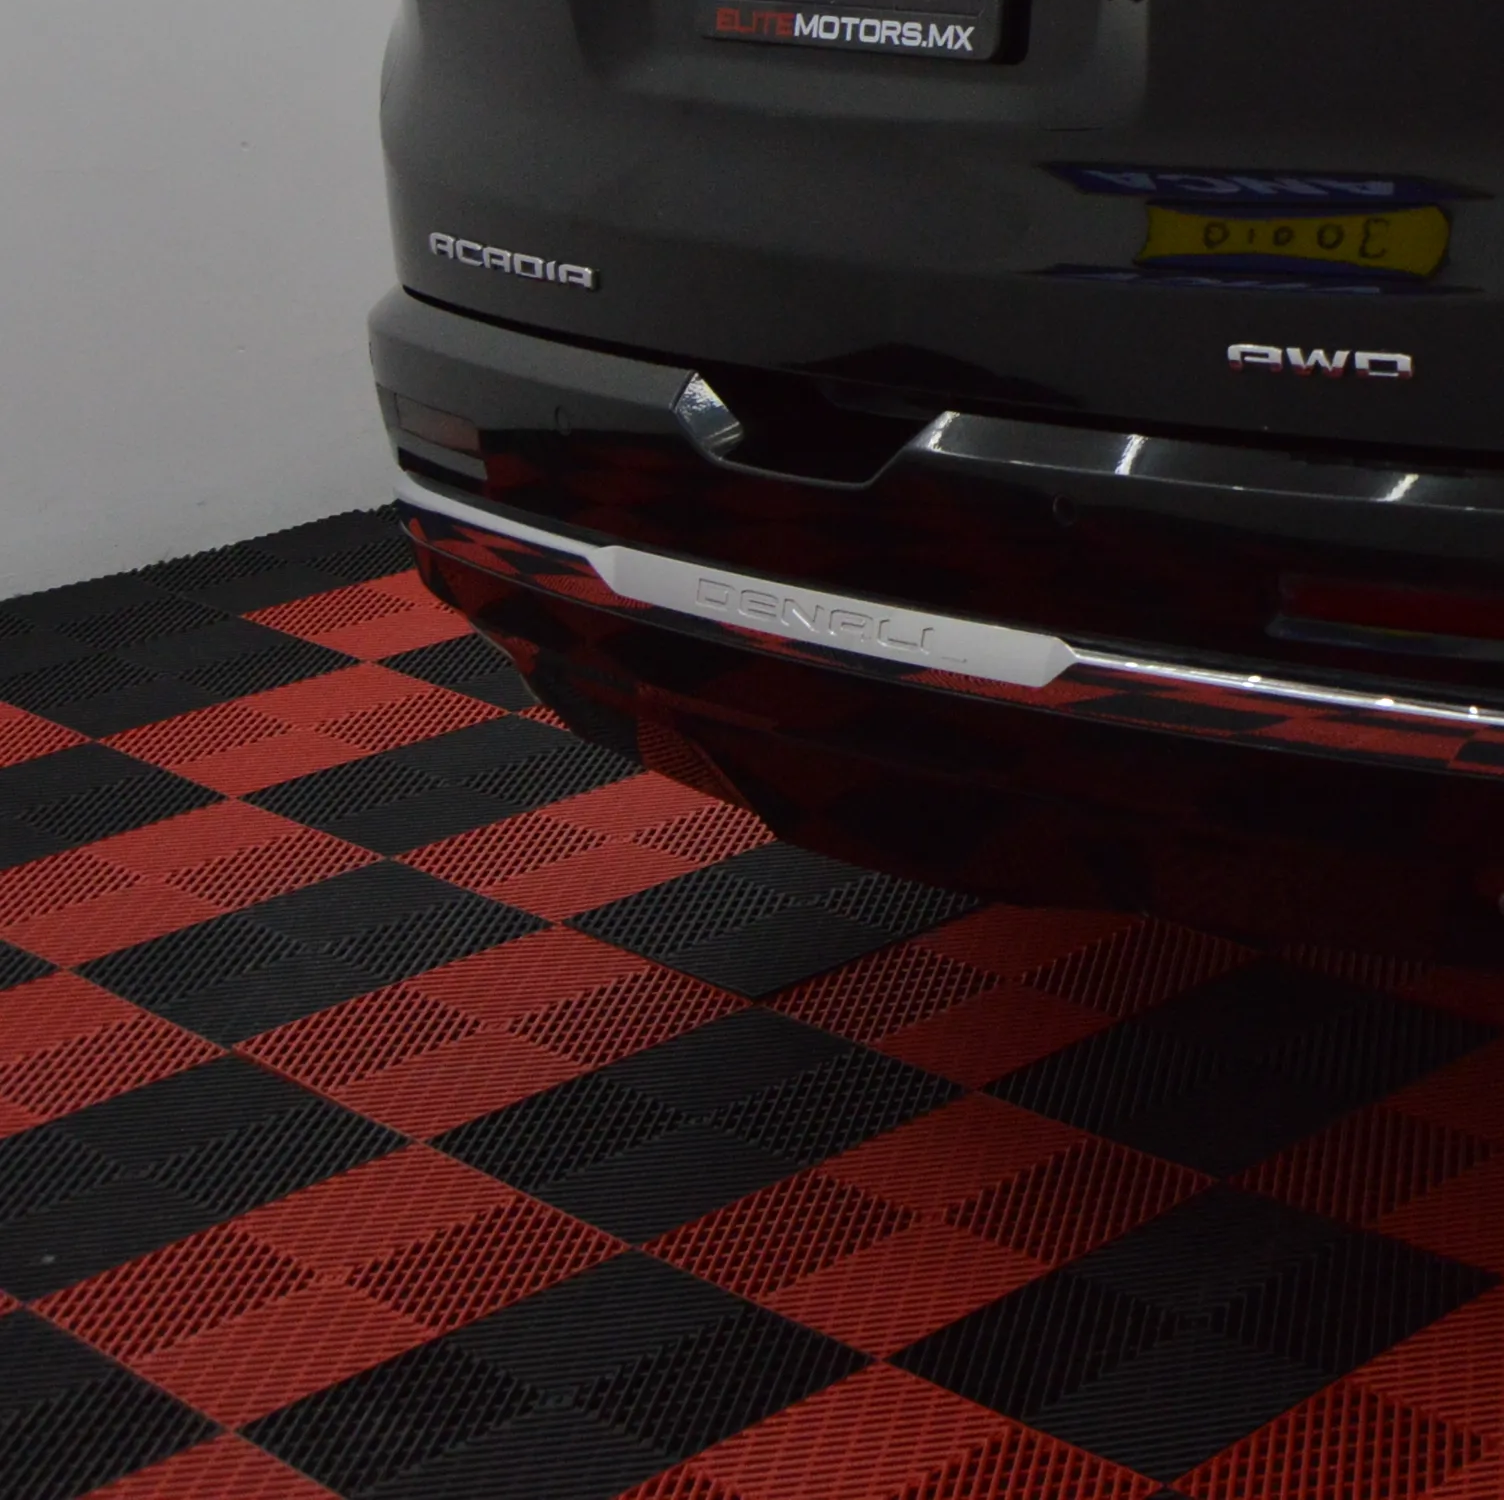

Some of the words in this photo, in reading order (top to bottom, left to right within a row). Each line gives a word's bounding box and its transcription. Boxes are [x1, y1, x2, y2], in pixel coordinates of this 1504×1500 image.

[429, 231, 596, 290] ACADIA
[1225, 342, 1415, 379] AWD
[693, 577, 936, 657] DENALI
